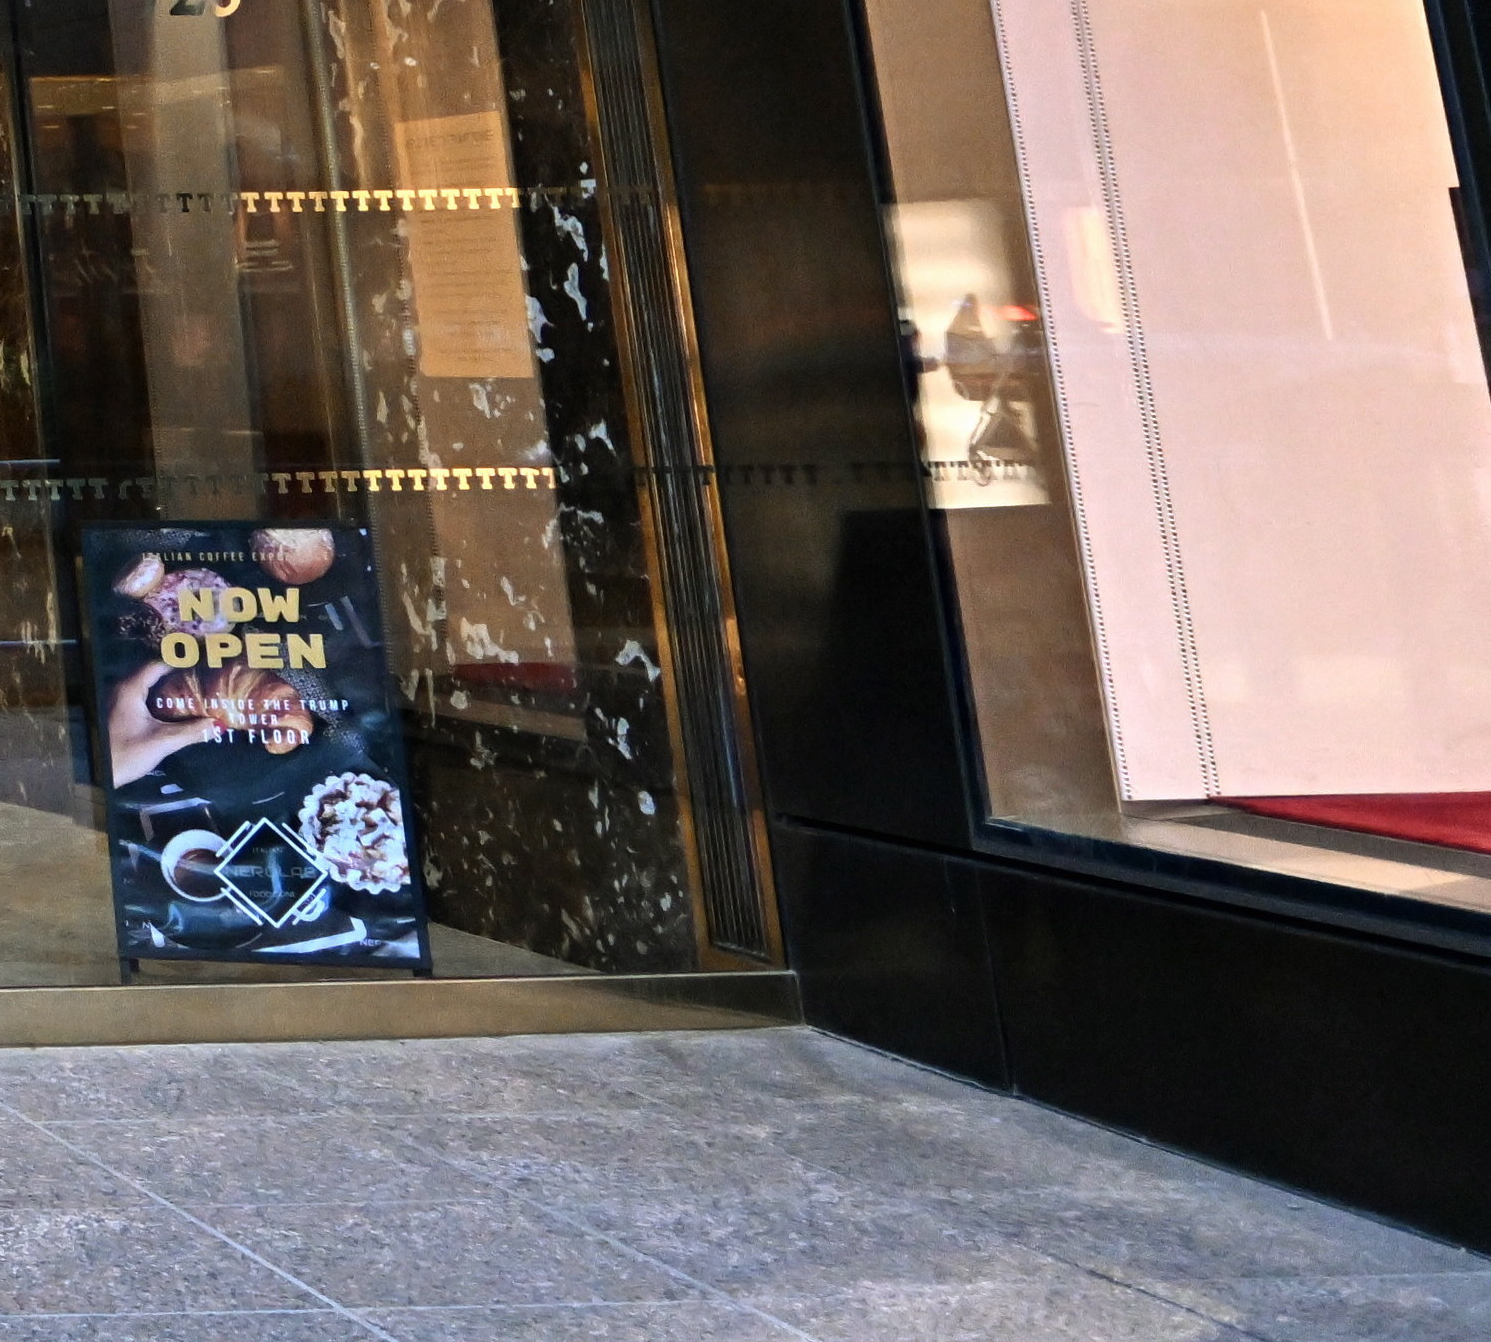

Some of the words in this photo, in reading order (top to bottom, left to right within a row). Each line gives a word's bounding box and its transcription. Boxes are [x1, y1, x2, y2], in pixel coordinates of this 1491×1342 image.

[199, 552, 245, 562] COFFEE
[178, 587, 300, 623] NOW
[159, 633, 327, 669] OPEN
[156, 697, 195, 710] COME
[203, 697, 255, 710] INSIDE
[262, 698, 291, 711] THE
[299, 698, 349, 711] TRUMP
[228, 713, 279, 725] TOWER
[202, 728, 235, 744] 1ST
[248, 728, 311, 745] FLOOR
